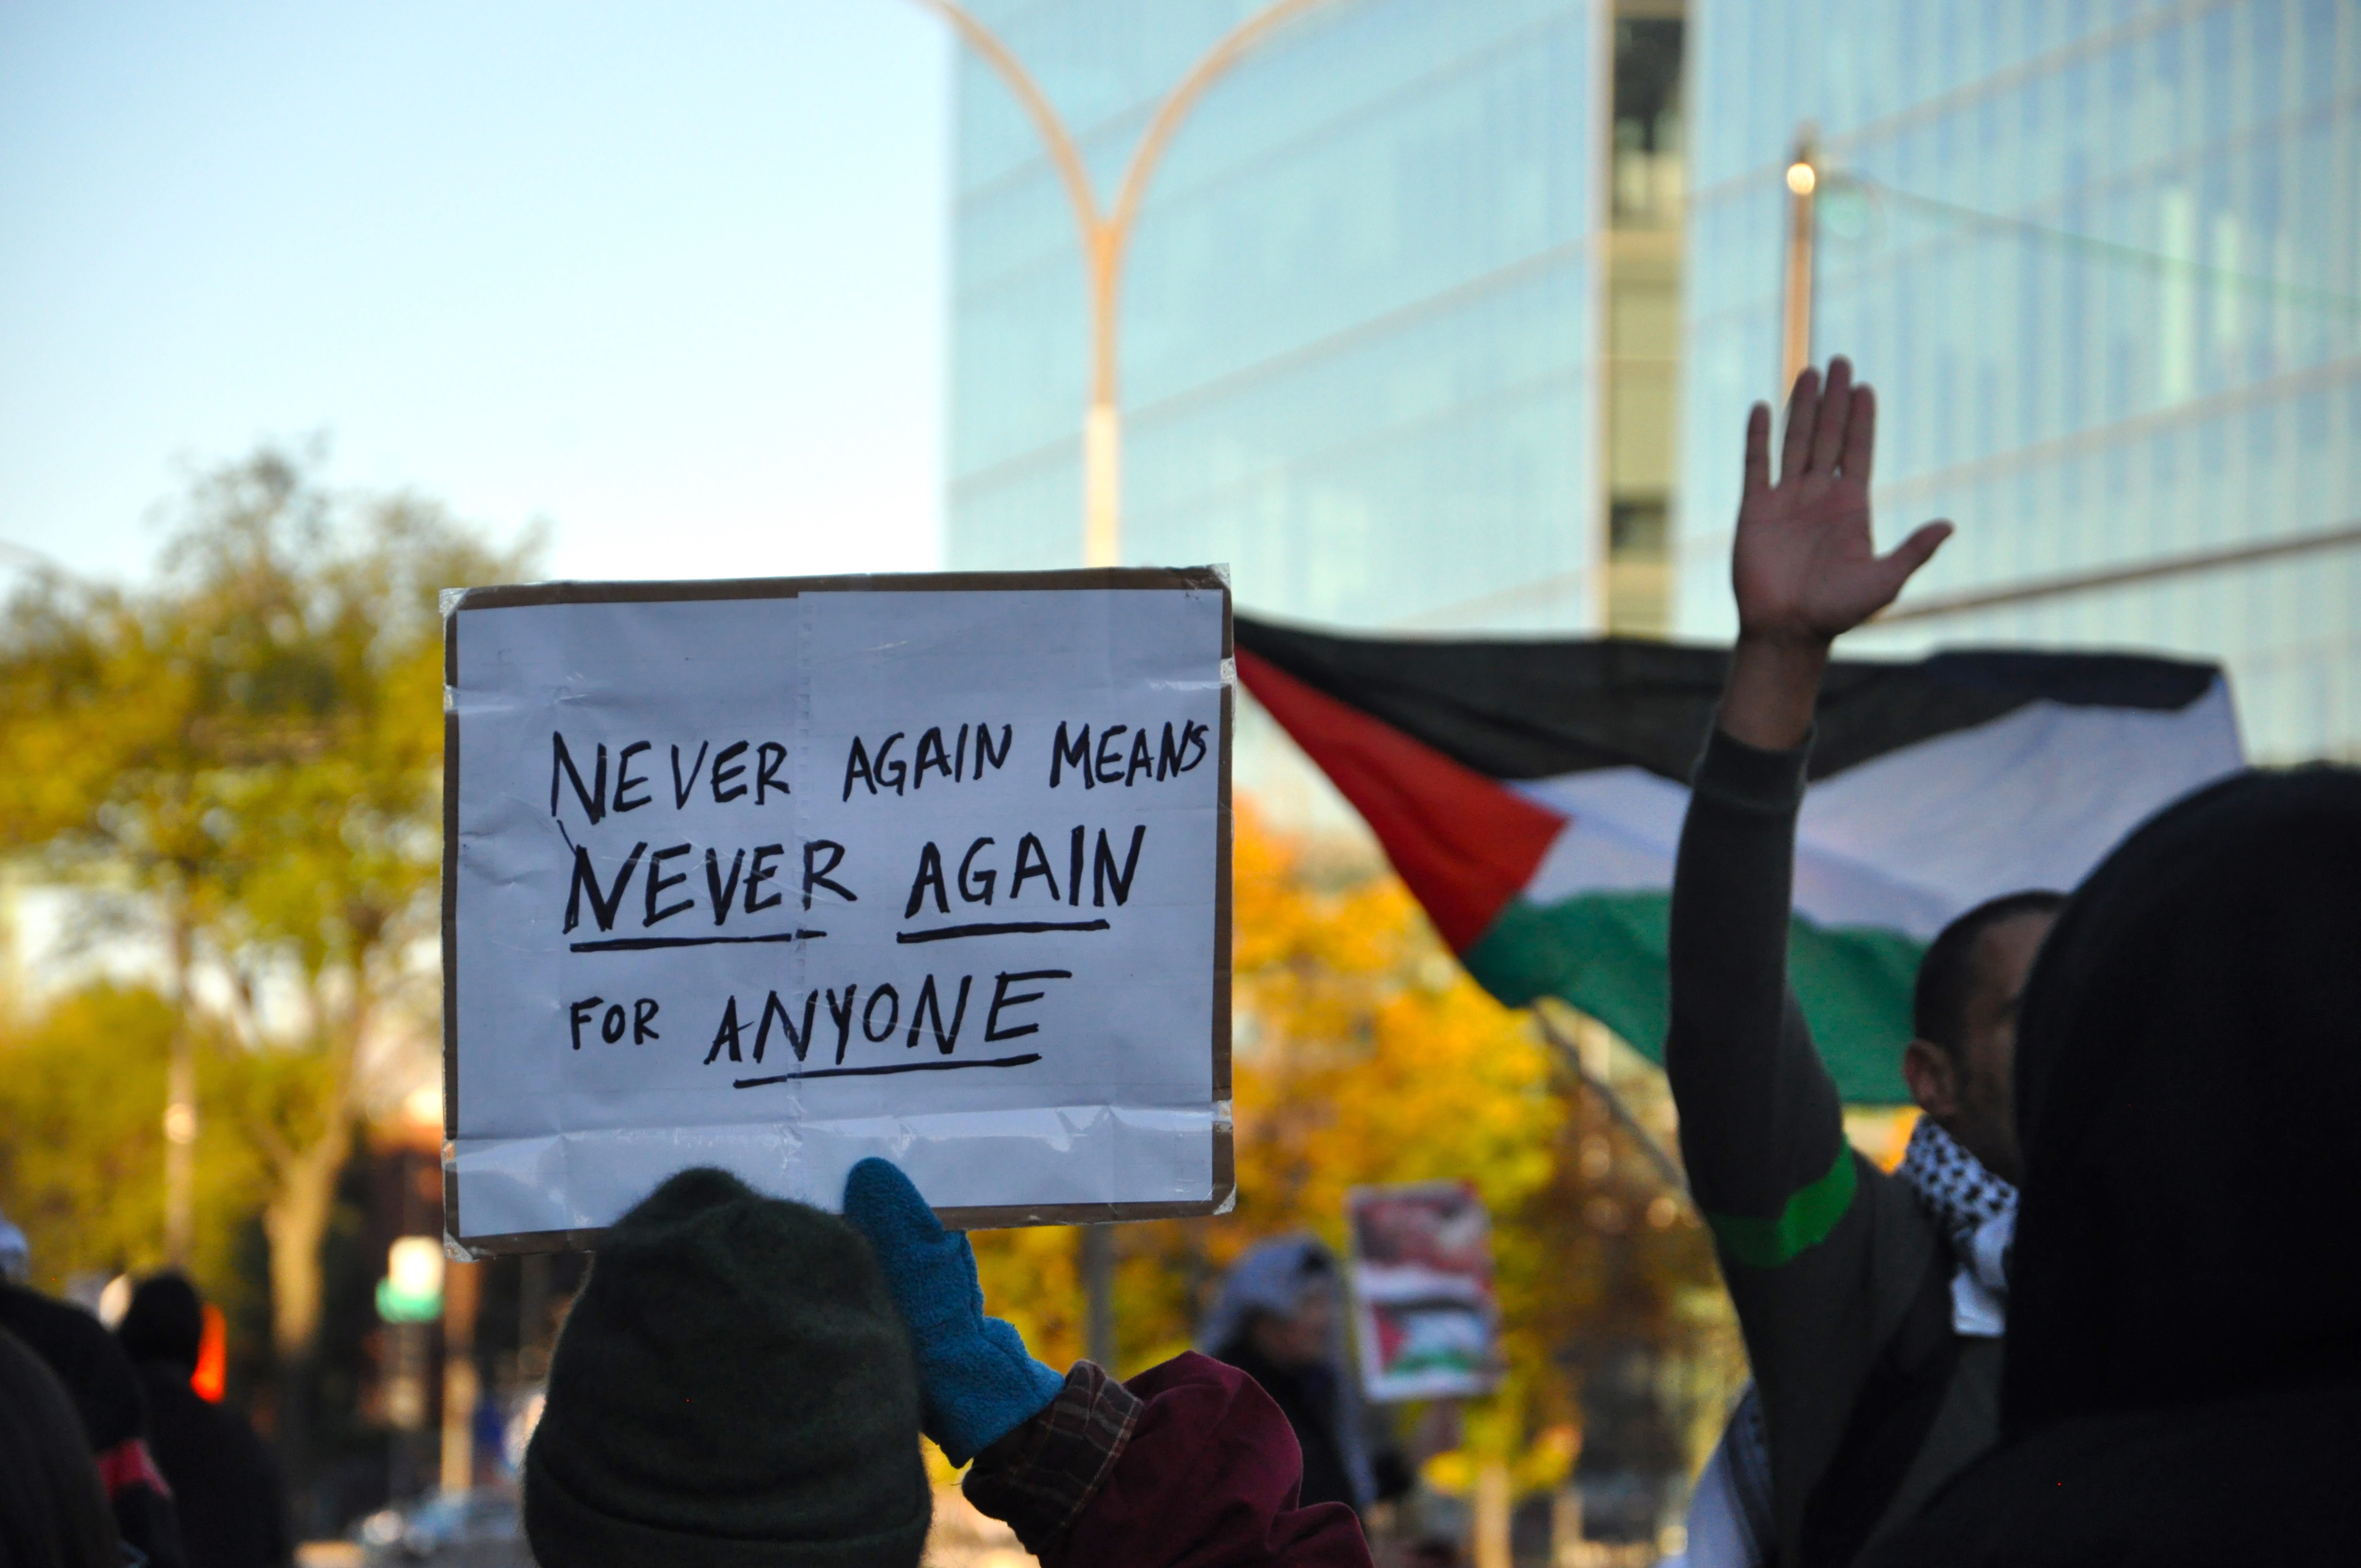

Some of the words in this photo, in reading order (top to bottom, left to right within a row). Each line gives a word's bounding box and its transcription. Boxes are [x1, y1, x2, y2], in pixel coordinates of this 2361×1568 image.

[551, 731, 790, 824] NEVER
[843, 723, 1012, 802] AGAIN
[1049, 720, 1209, 790] MEANS
[557, 822, 857, 934] NEVER
[904, 825, 1146, 919] AGAIN
[570, 997, 659, 1050] FOR
[704, 970, 1072, 1065] ANYONE
